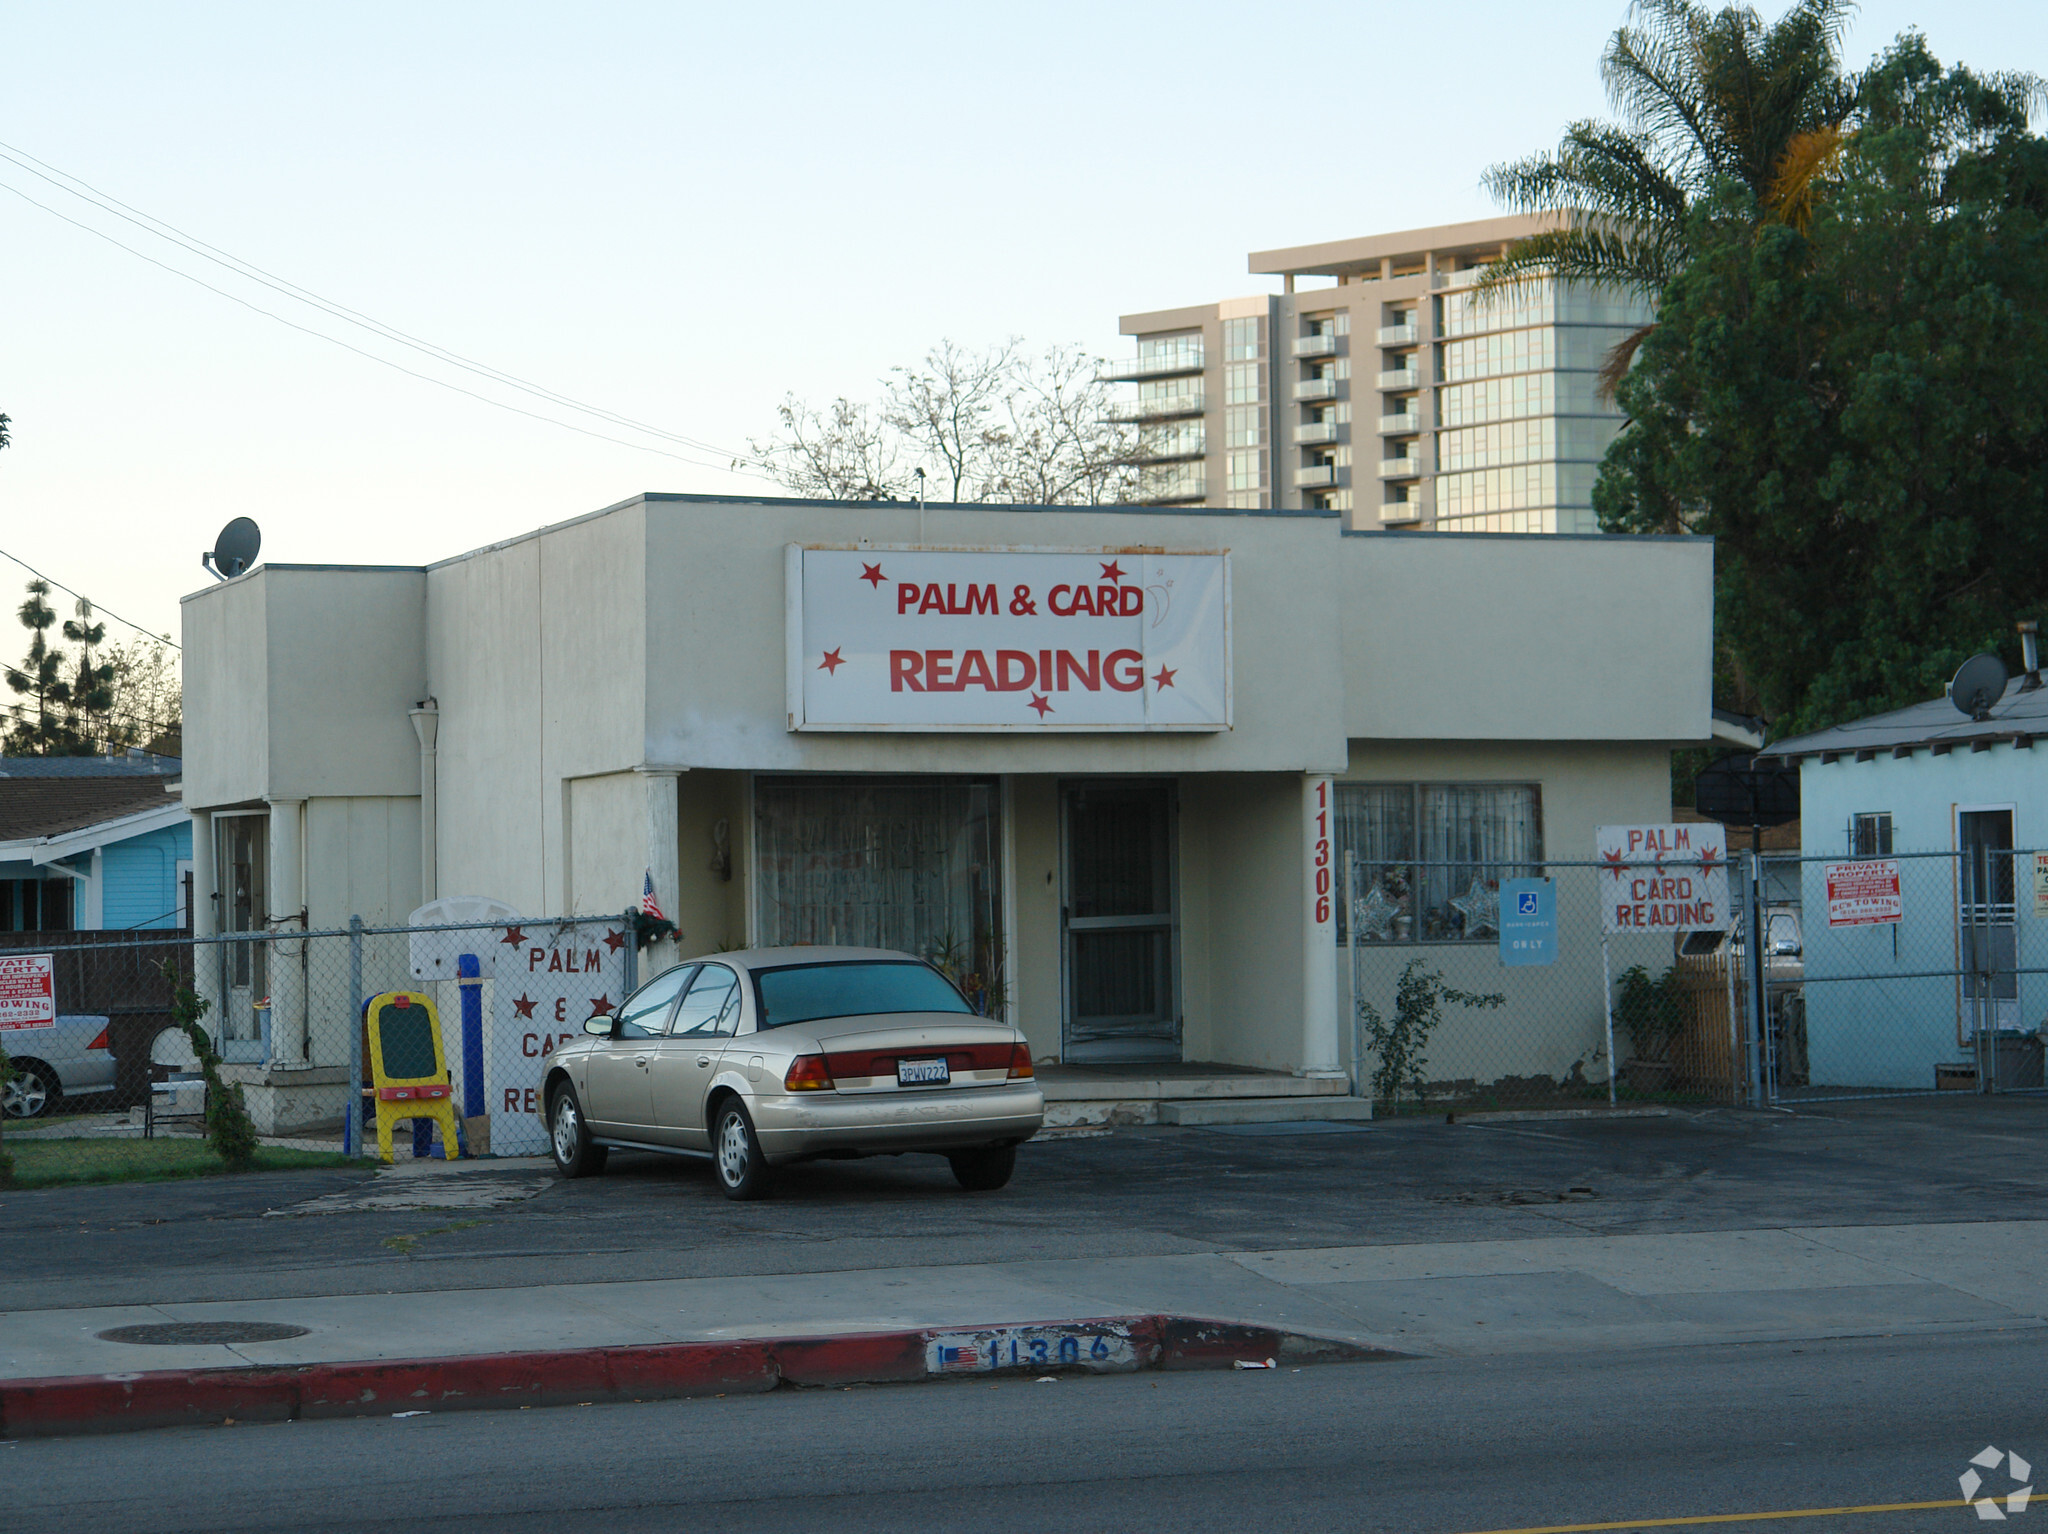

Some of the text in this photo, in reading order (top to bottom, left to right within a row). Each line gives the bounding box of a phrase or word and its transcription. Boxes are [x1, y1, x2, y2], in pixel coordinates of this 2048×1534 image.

[898, 583, 1144, 616] PALM & CARD
[889, 649, 1145, 692] READING
[1628, 828, 1690, 851] PALM
[1315, 781, 1330, 923] 11306
[1830, 868, 1894, 878] PROPERTY
[1836, 864, 1887, 872] PRIVATE
[1631, 878, 1692, 901] CARD
[1617, 902, 1714, 927] READING
[1854, 899, 1898, 907] TOWING
[1513, 940, 1543, 949] ONLY
[529, 948, 601, 973] PALM
[901, 1066, 949, 1082] 3PWV222
[988, 1336, 1108, 1369] 11306
